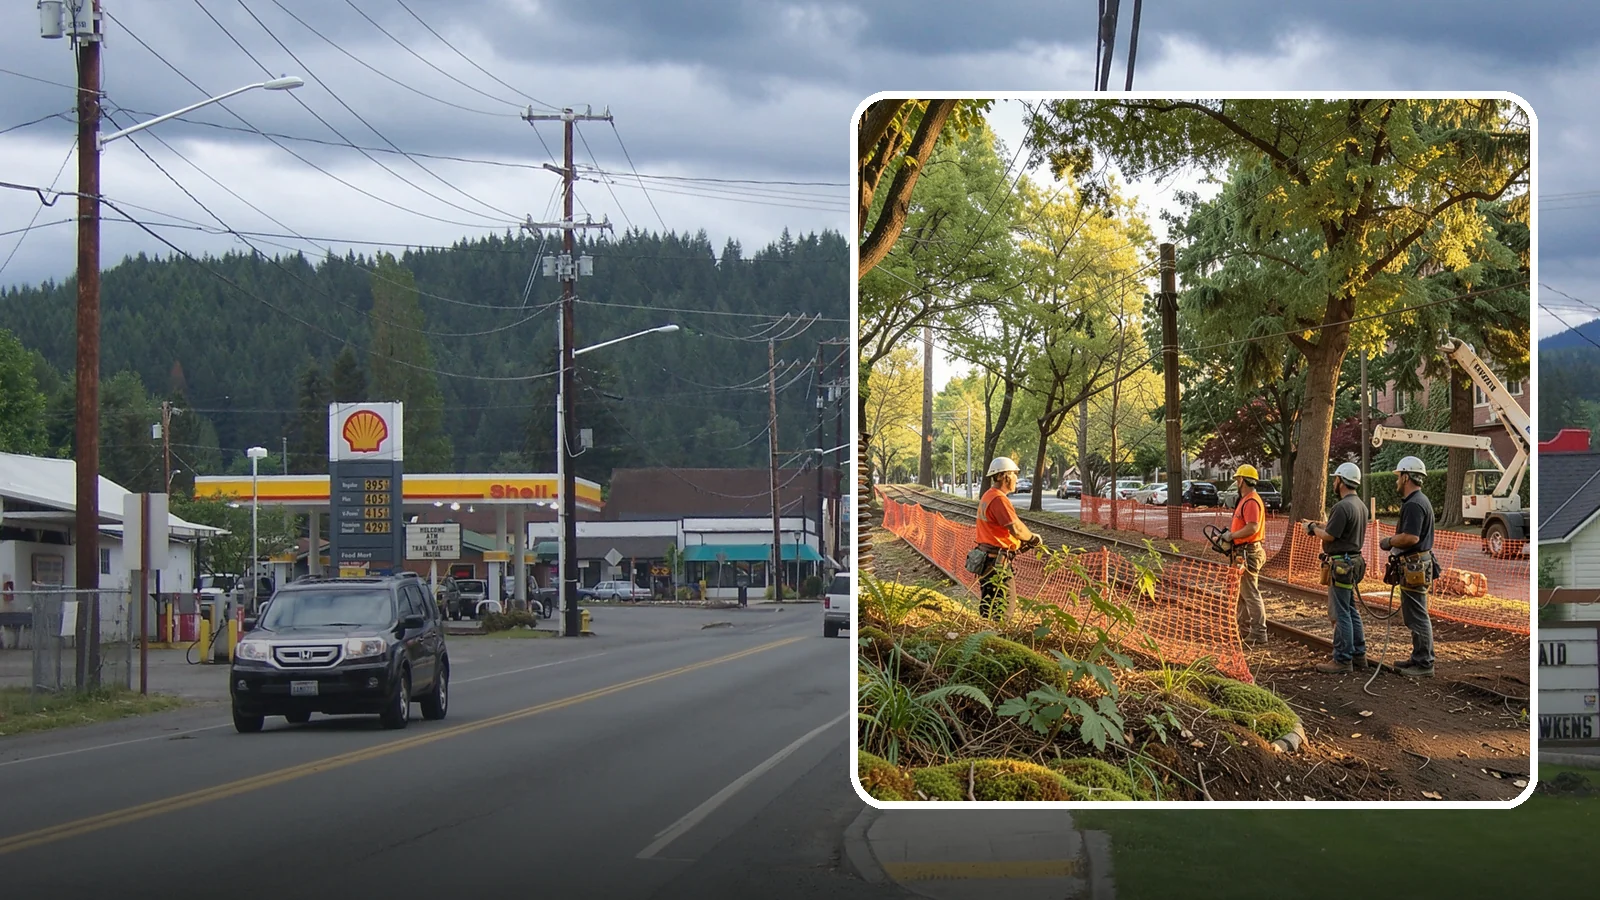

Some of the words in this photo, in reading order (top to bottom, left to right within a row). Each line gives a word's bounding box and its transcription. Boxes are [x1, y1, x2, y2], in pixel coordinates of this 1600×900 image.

[365, 479, 384, 490] 395
[490, 484, 547, 499] Shell
[365, 493, 384, 505] 405
[365, 507, 384, 518] 415
[365, 522, 384, 533] 429
